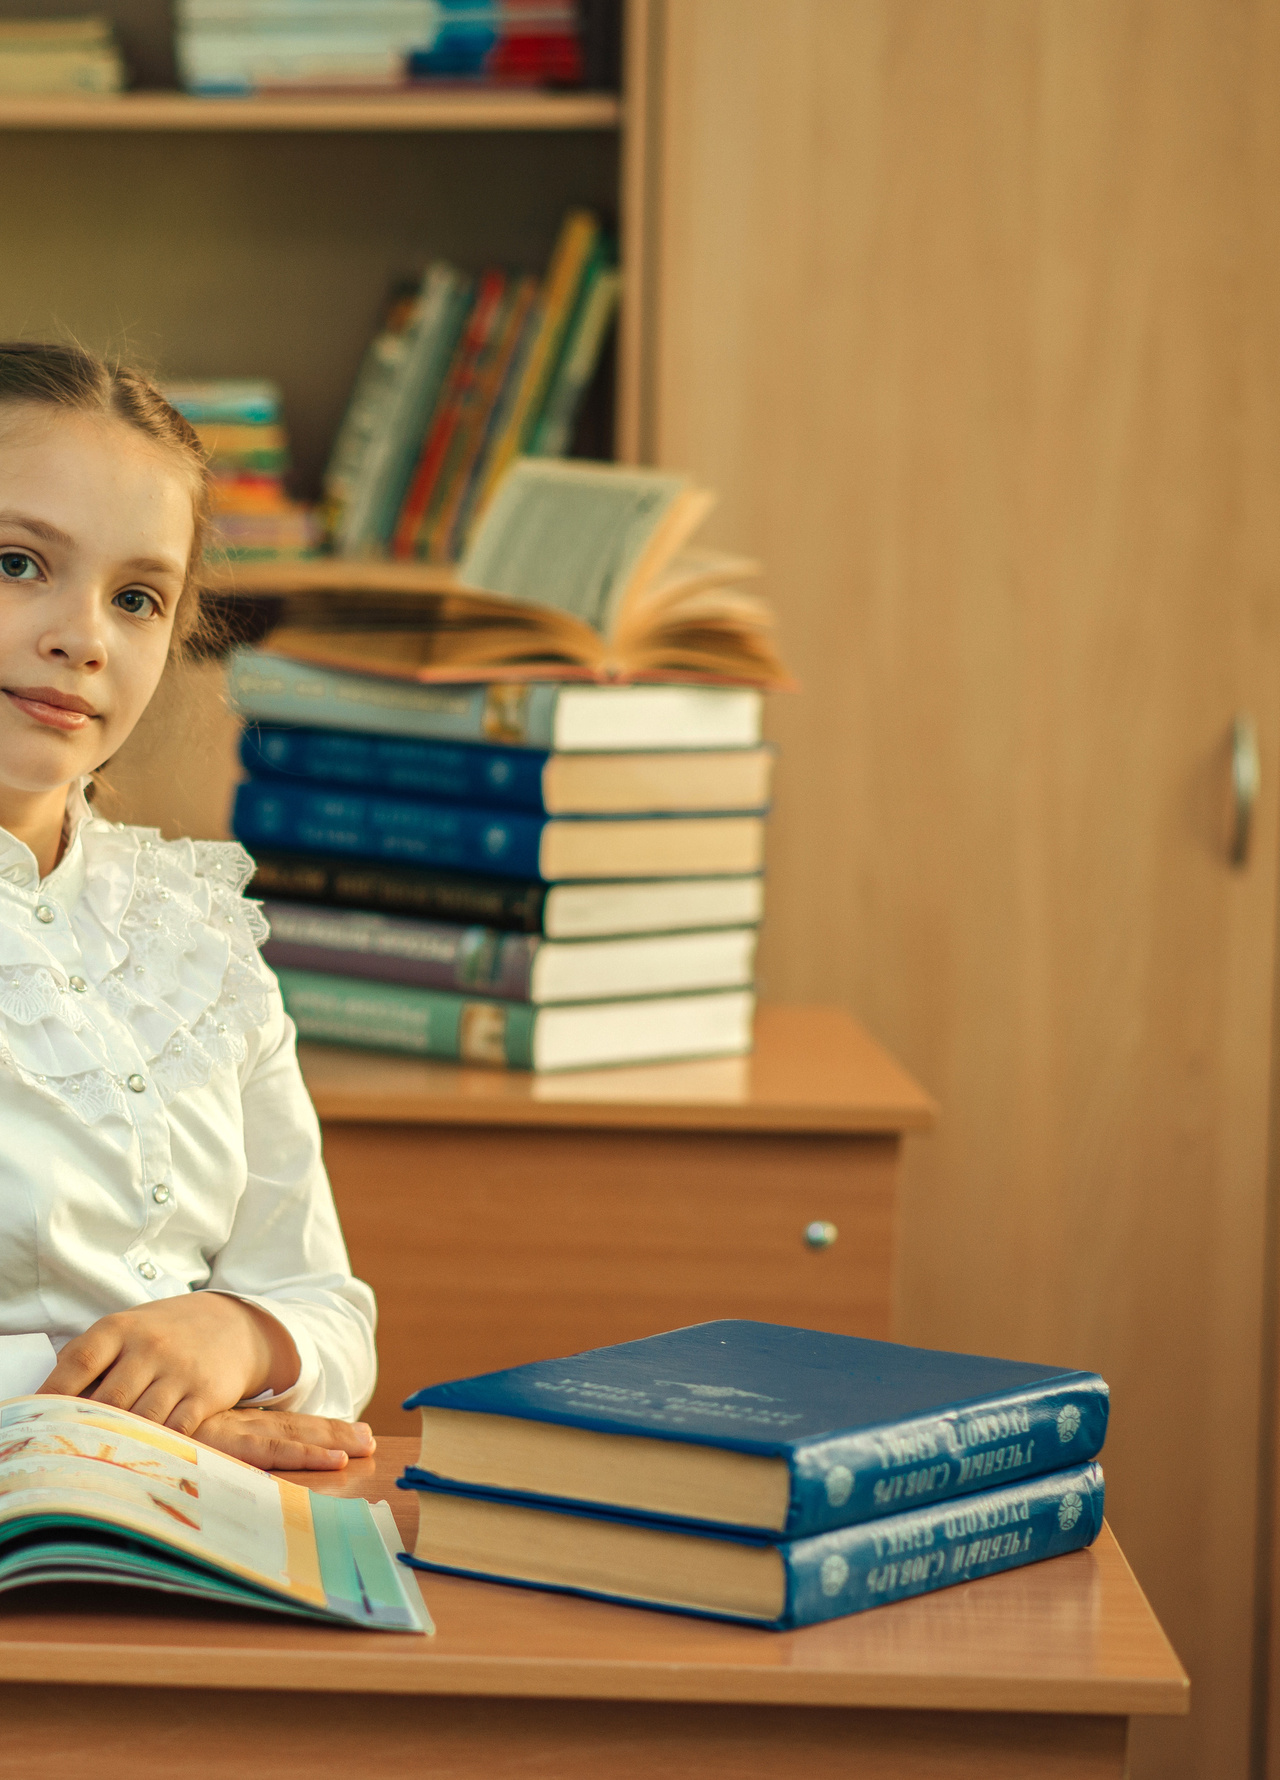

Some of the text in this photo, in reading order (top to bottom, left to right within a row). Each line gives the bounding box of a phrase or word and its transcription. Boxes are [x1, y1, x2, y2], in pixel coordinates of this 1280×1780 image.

[941, 1405, 1031, 1453] РУССКОГО
[873, 1462, 951, 1505] СЛОВАРЬ
[944, 1495, 1031, 1541] РУССКОГО
[867, 1526, 1034, 1593] УЧЕБНЫЙ СЛОВАРЬ
